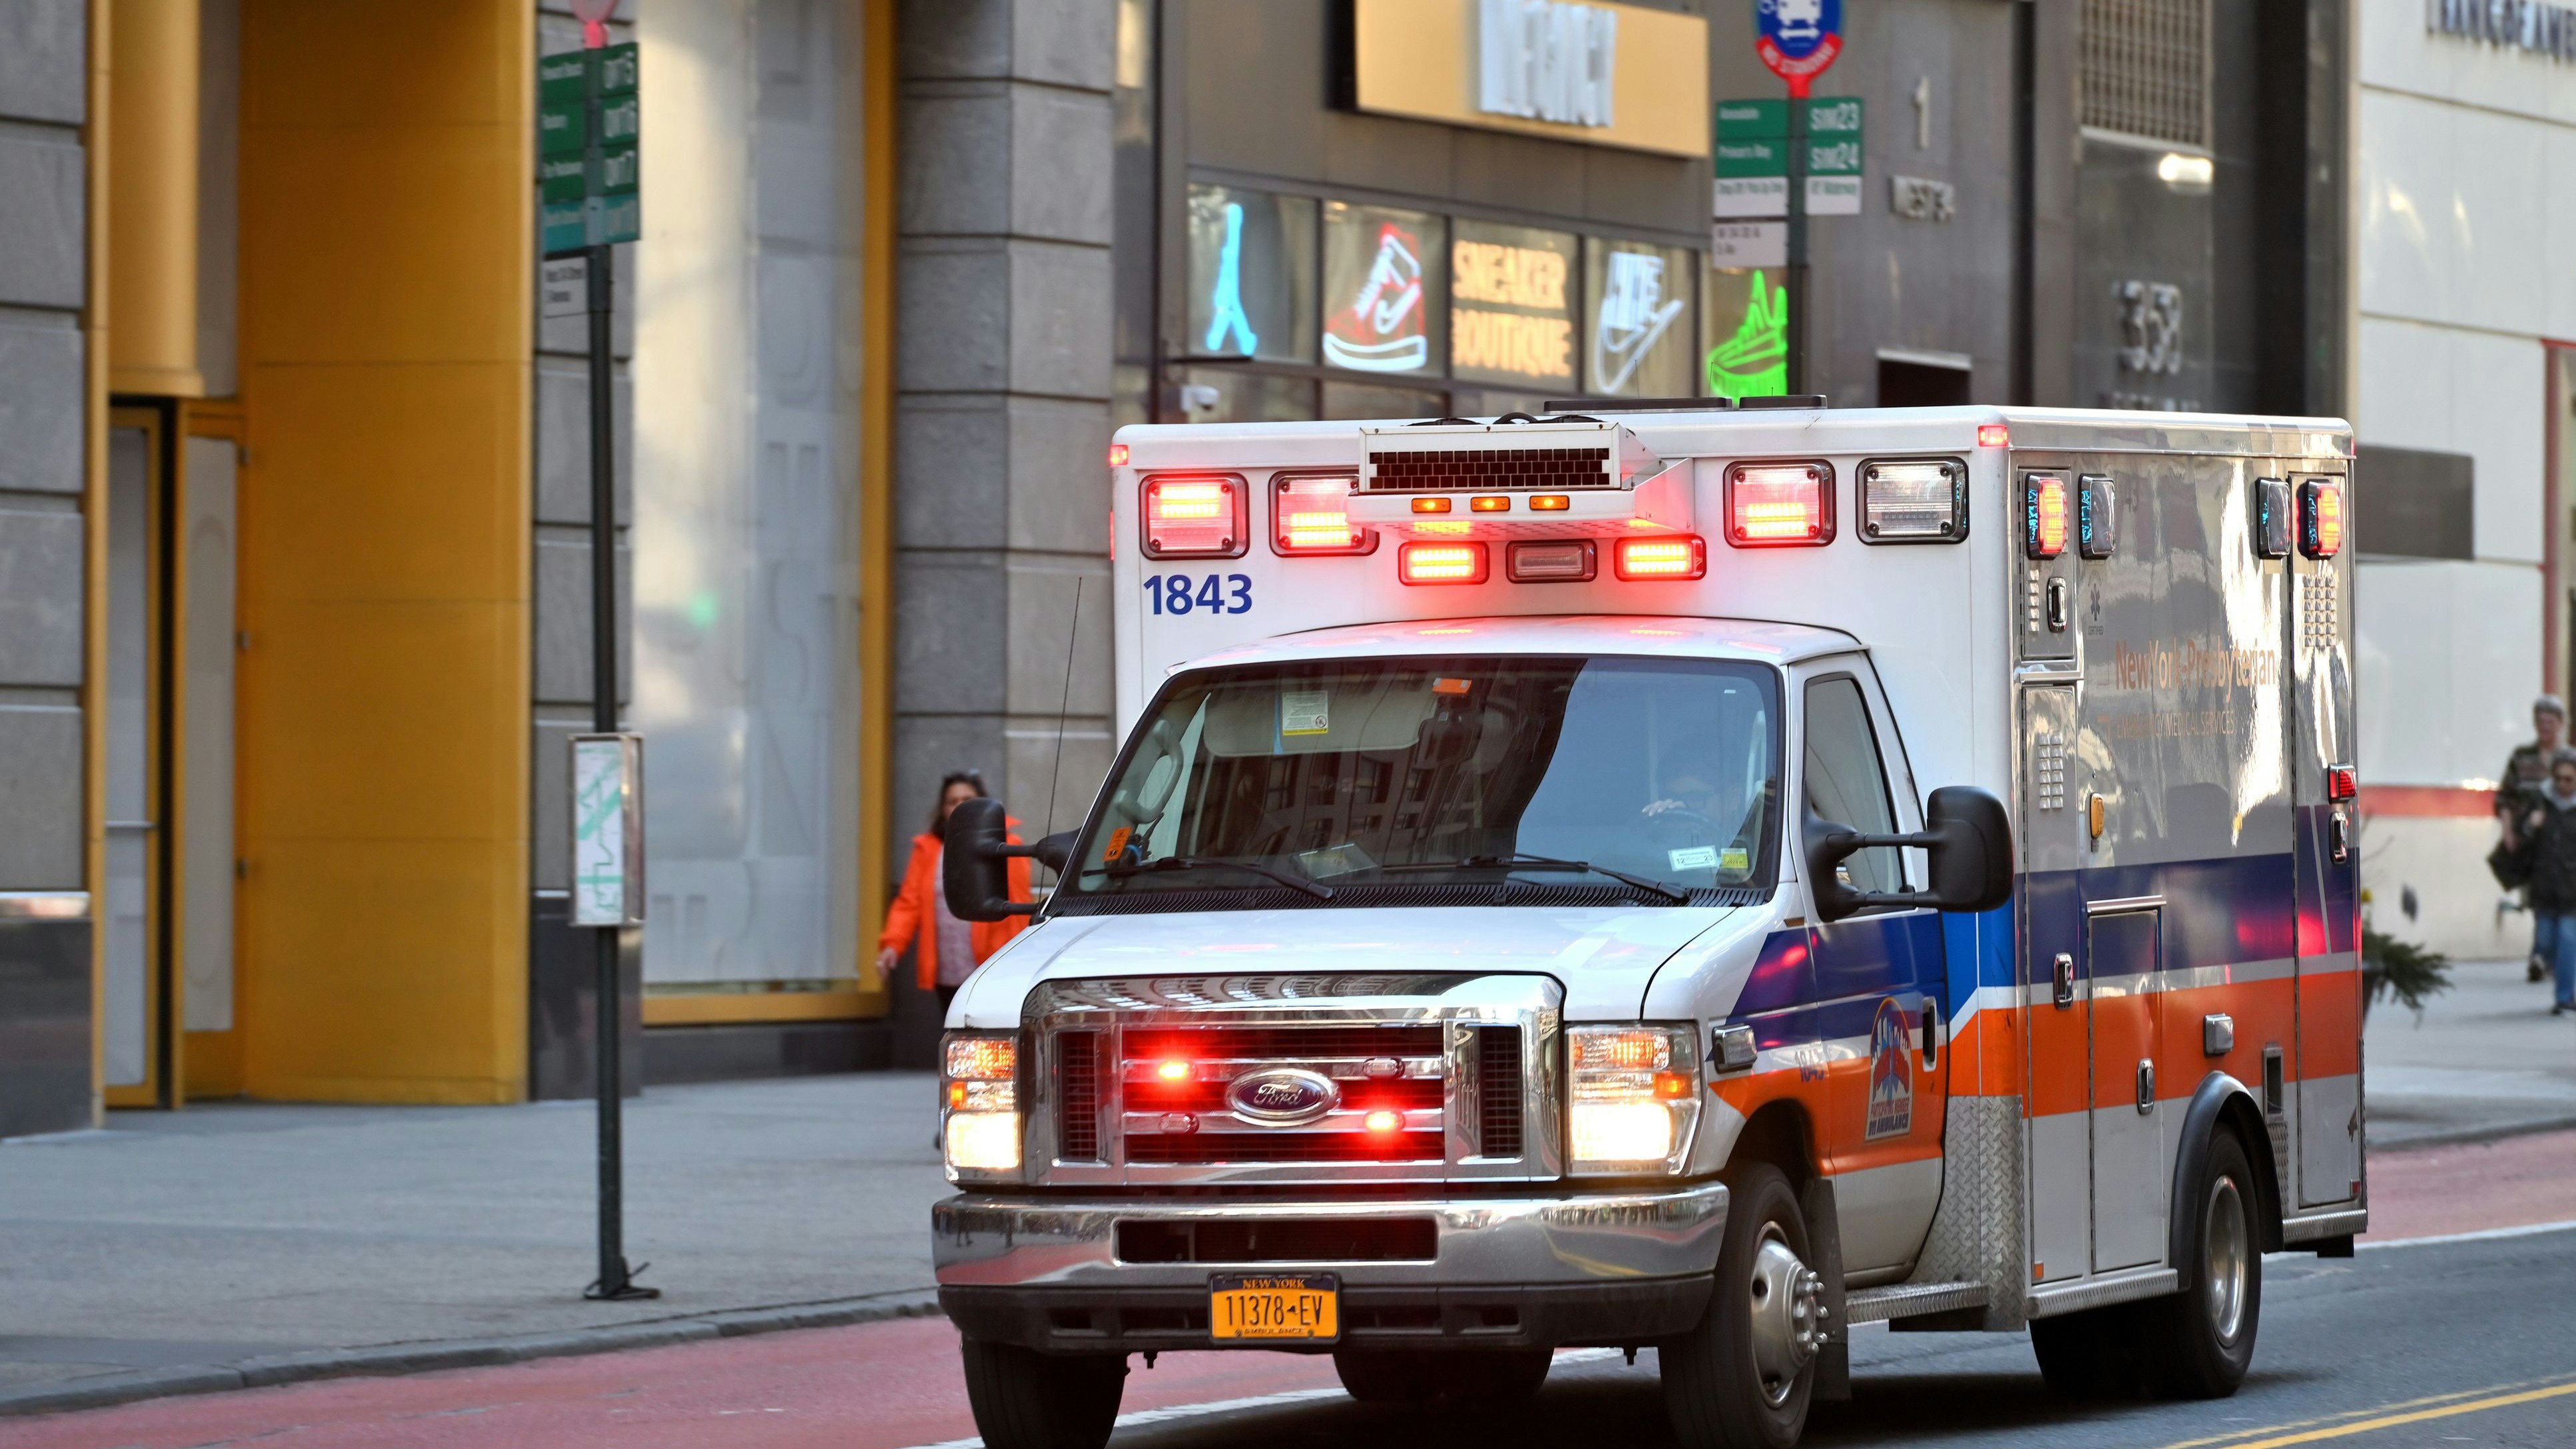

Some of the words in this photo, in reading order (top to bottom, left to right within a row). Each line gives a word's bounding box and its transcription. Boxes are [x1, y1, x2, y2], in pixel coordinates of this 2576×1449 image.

[1452, 240, 1567, 309] SNEAKER
[1451, 308, 1572, 377] BOUTIQUE
[1143, 573, 1252, 615] 1843
[2088, 625, 2104, 636] CERTIFIED
[2166, 711, 2199, 736] MEDICAL
[2200, 710, 2234, 735] SERVICES
[1254, 1083, 1303, 1106] Ford
[1243, 1279, 1270, 1289] NEW
[1274, 1279, 1305, 1289] YORK
[1226, 1295, 1284, 1326] 11378
